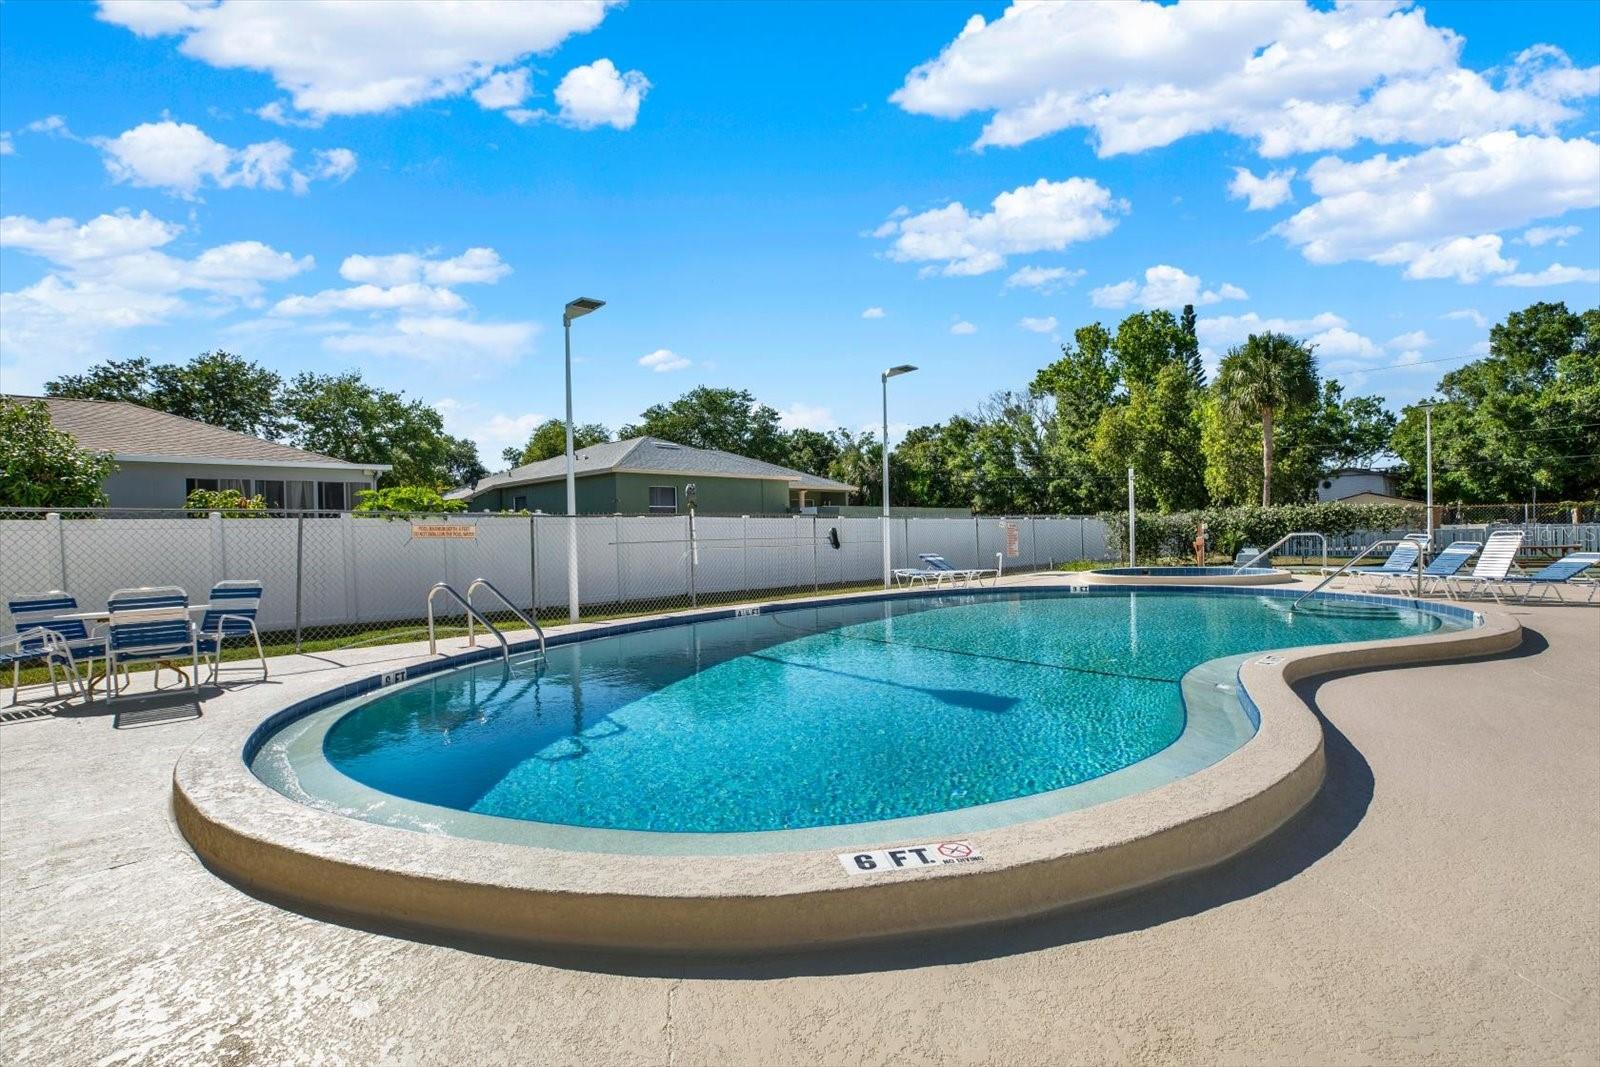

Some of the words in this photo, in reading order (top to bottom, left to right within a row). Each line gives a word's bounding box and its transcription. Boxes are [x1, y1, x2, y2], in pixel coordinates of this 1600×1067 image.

[853, 854, 877, 870] 6
[888, 848, 936, 867] FT.
[956, 855, 984, 864] DIVING
